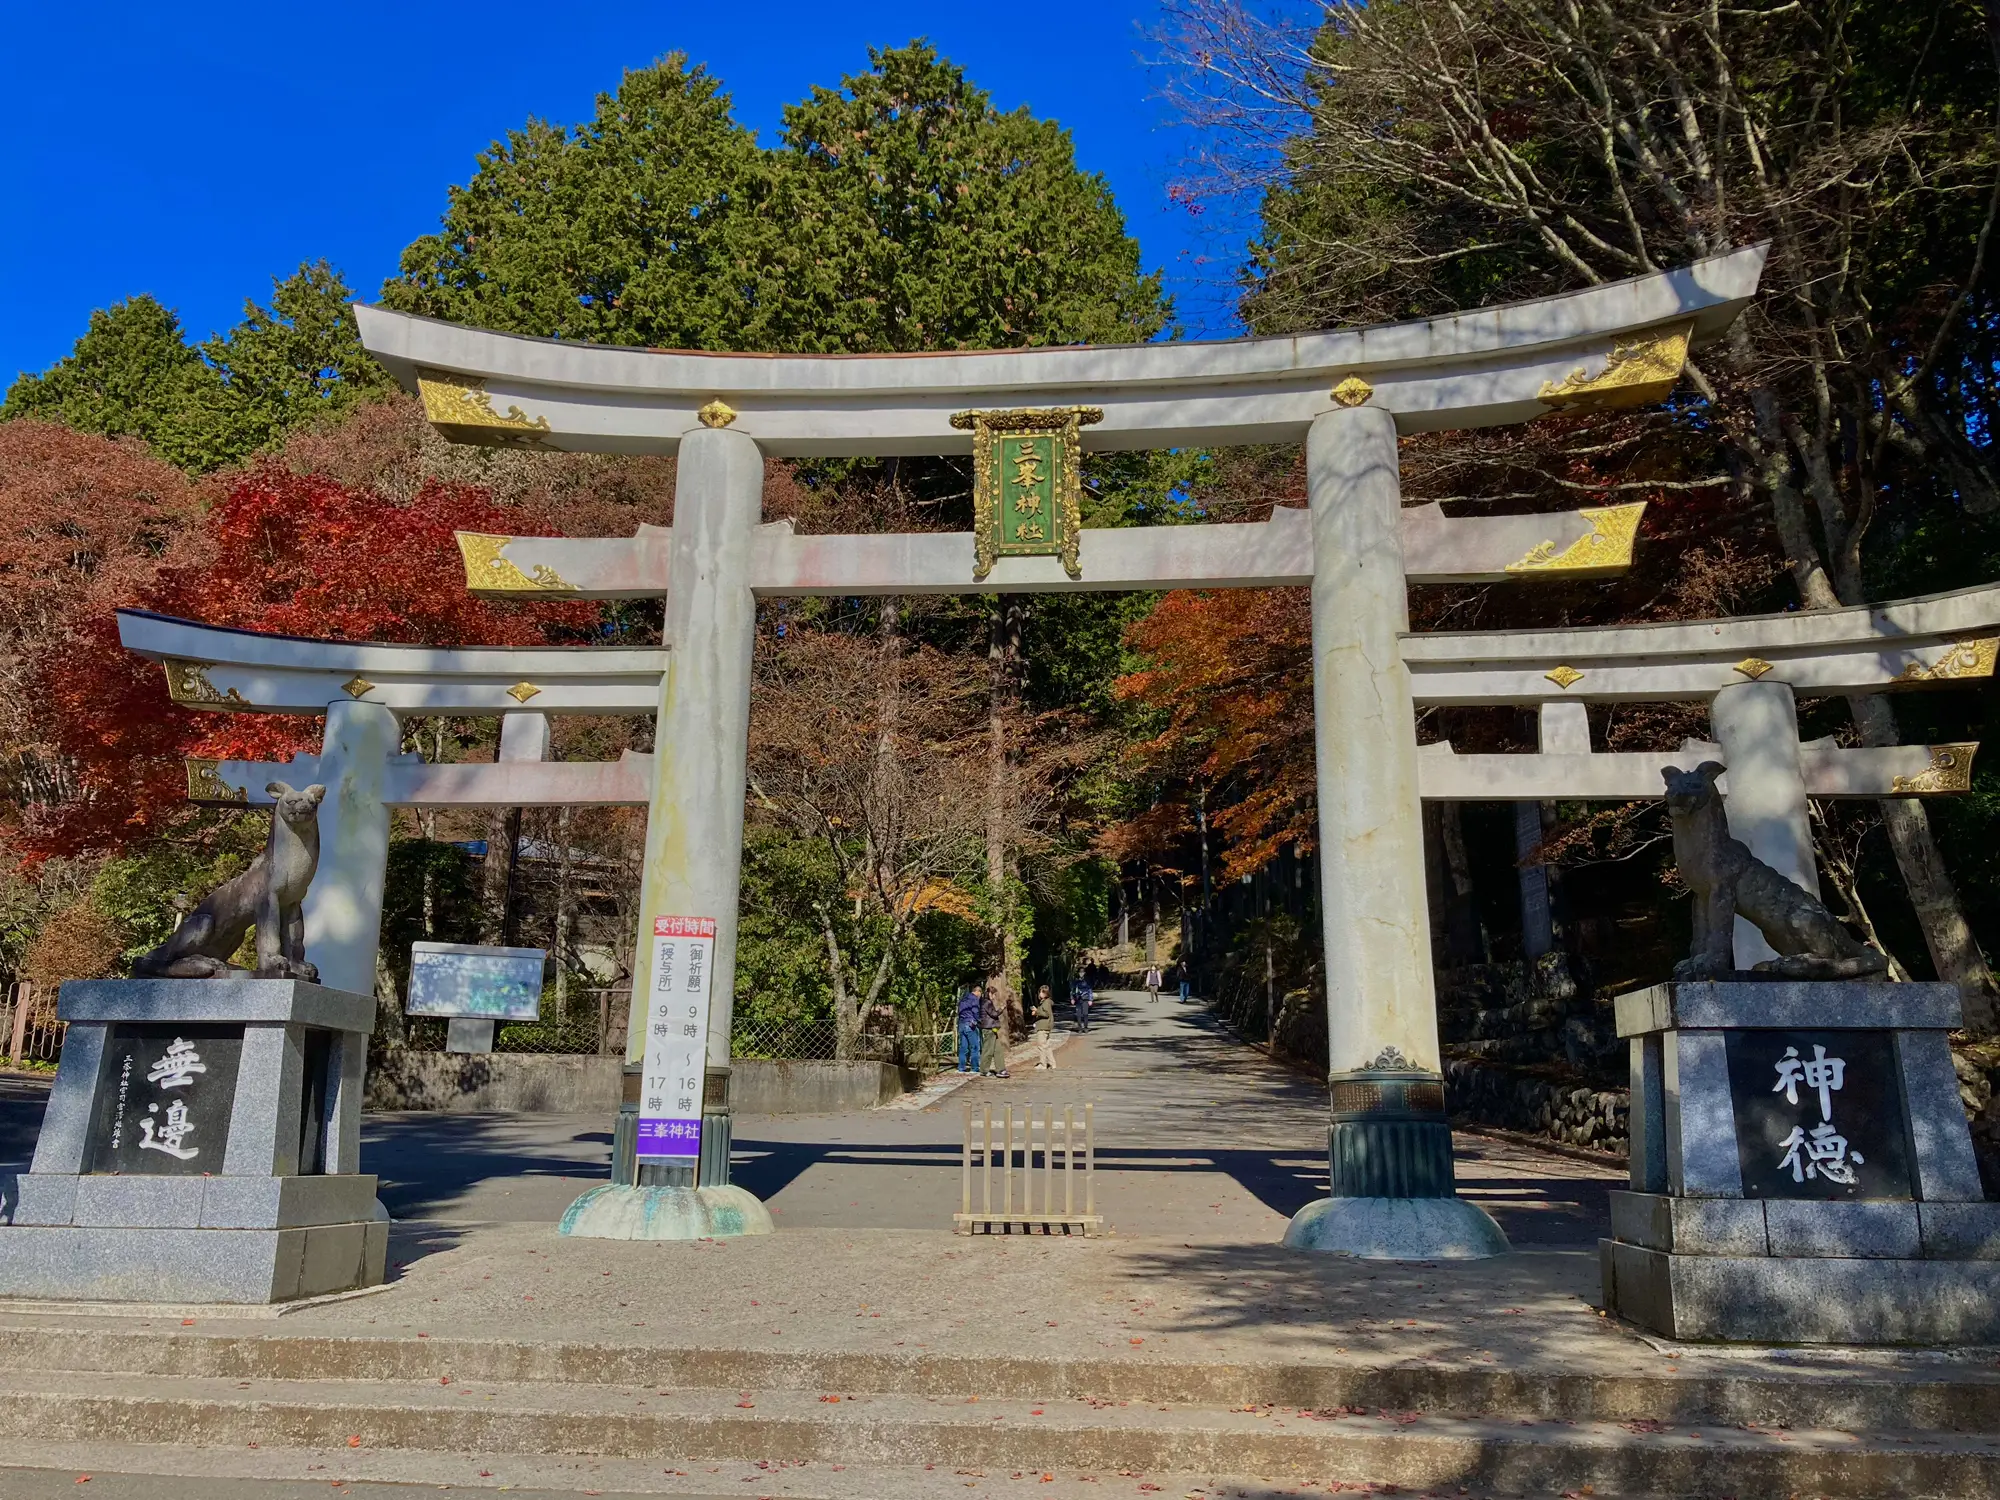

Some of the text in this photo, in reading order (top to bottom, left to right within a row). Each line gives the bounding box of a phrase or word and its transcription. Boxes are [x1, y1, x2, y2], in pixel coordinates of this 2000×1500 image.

[1012, 441, 1045, 540] 三峯神社
[655, 917, 714, 935] 受付時間
[638, 1121, 700, 1139] 三峯神社
